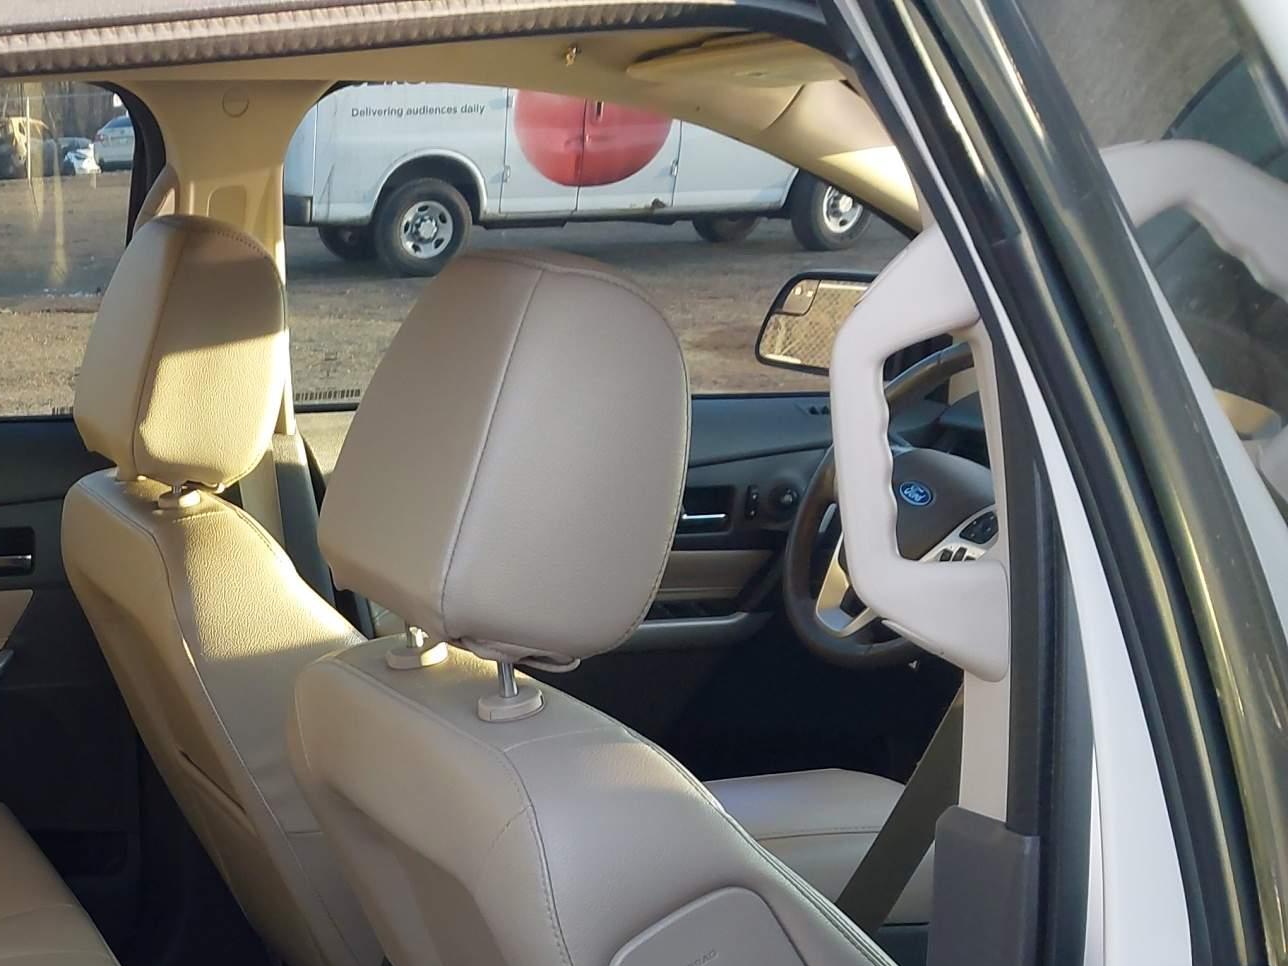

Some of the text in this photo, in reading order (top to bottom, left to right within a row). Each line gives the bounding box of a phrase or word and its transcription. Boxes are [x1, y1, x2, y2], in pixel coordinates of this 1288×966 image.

[351, 103, 486, 118] Delivering audiences daily
